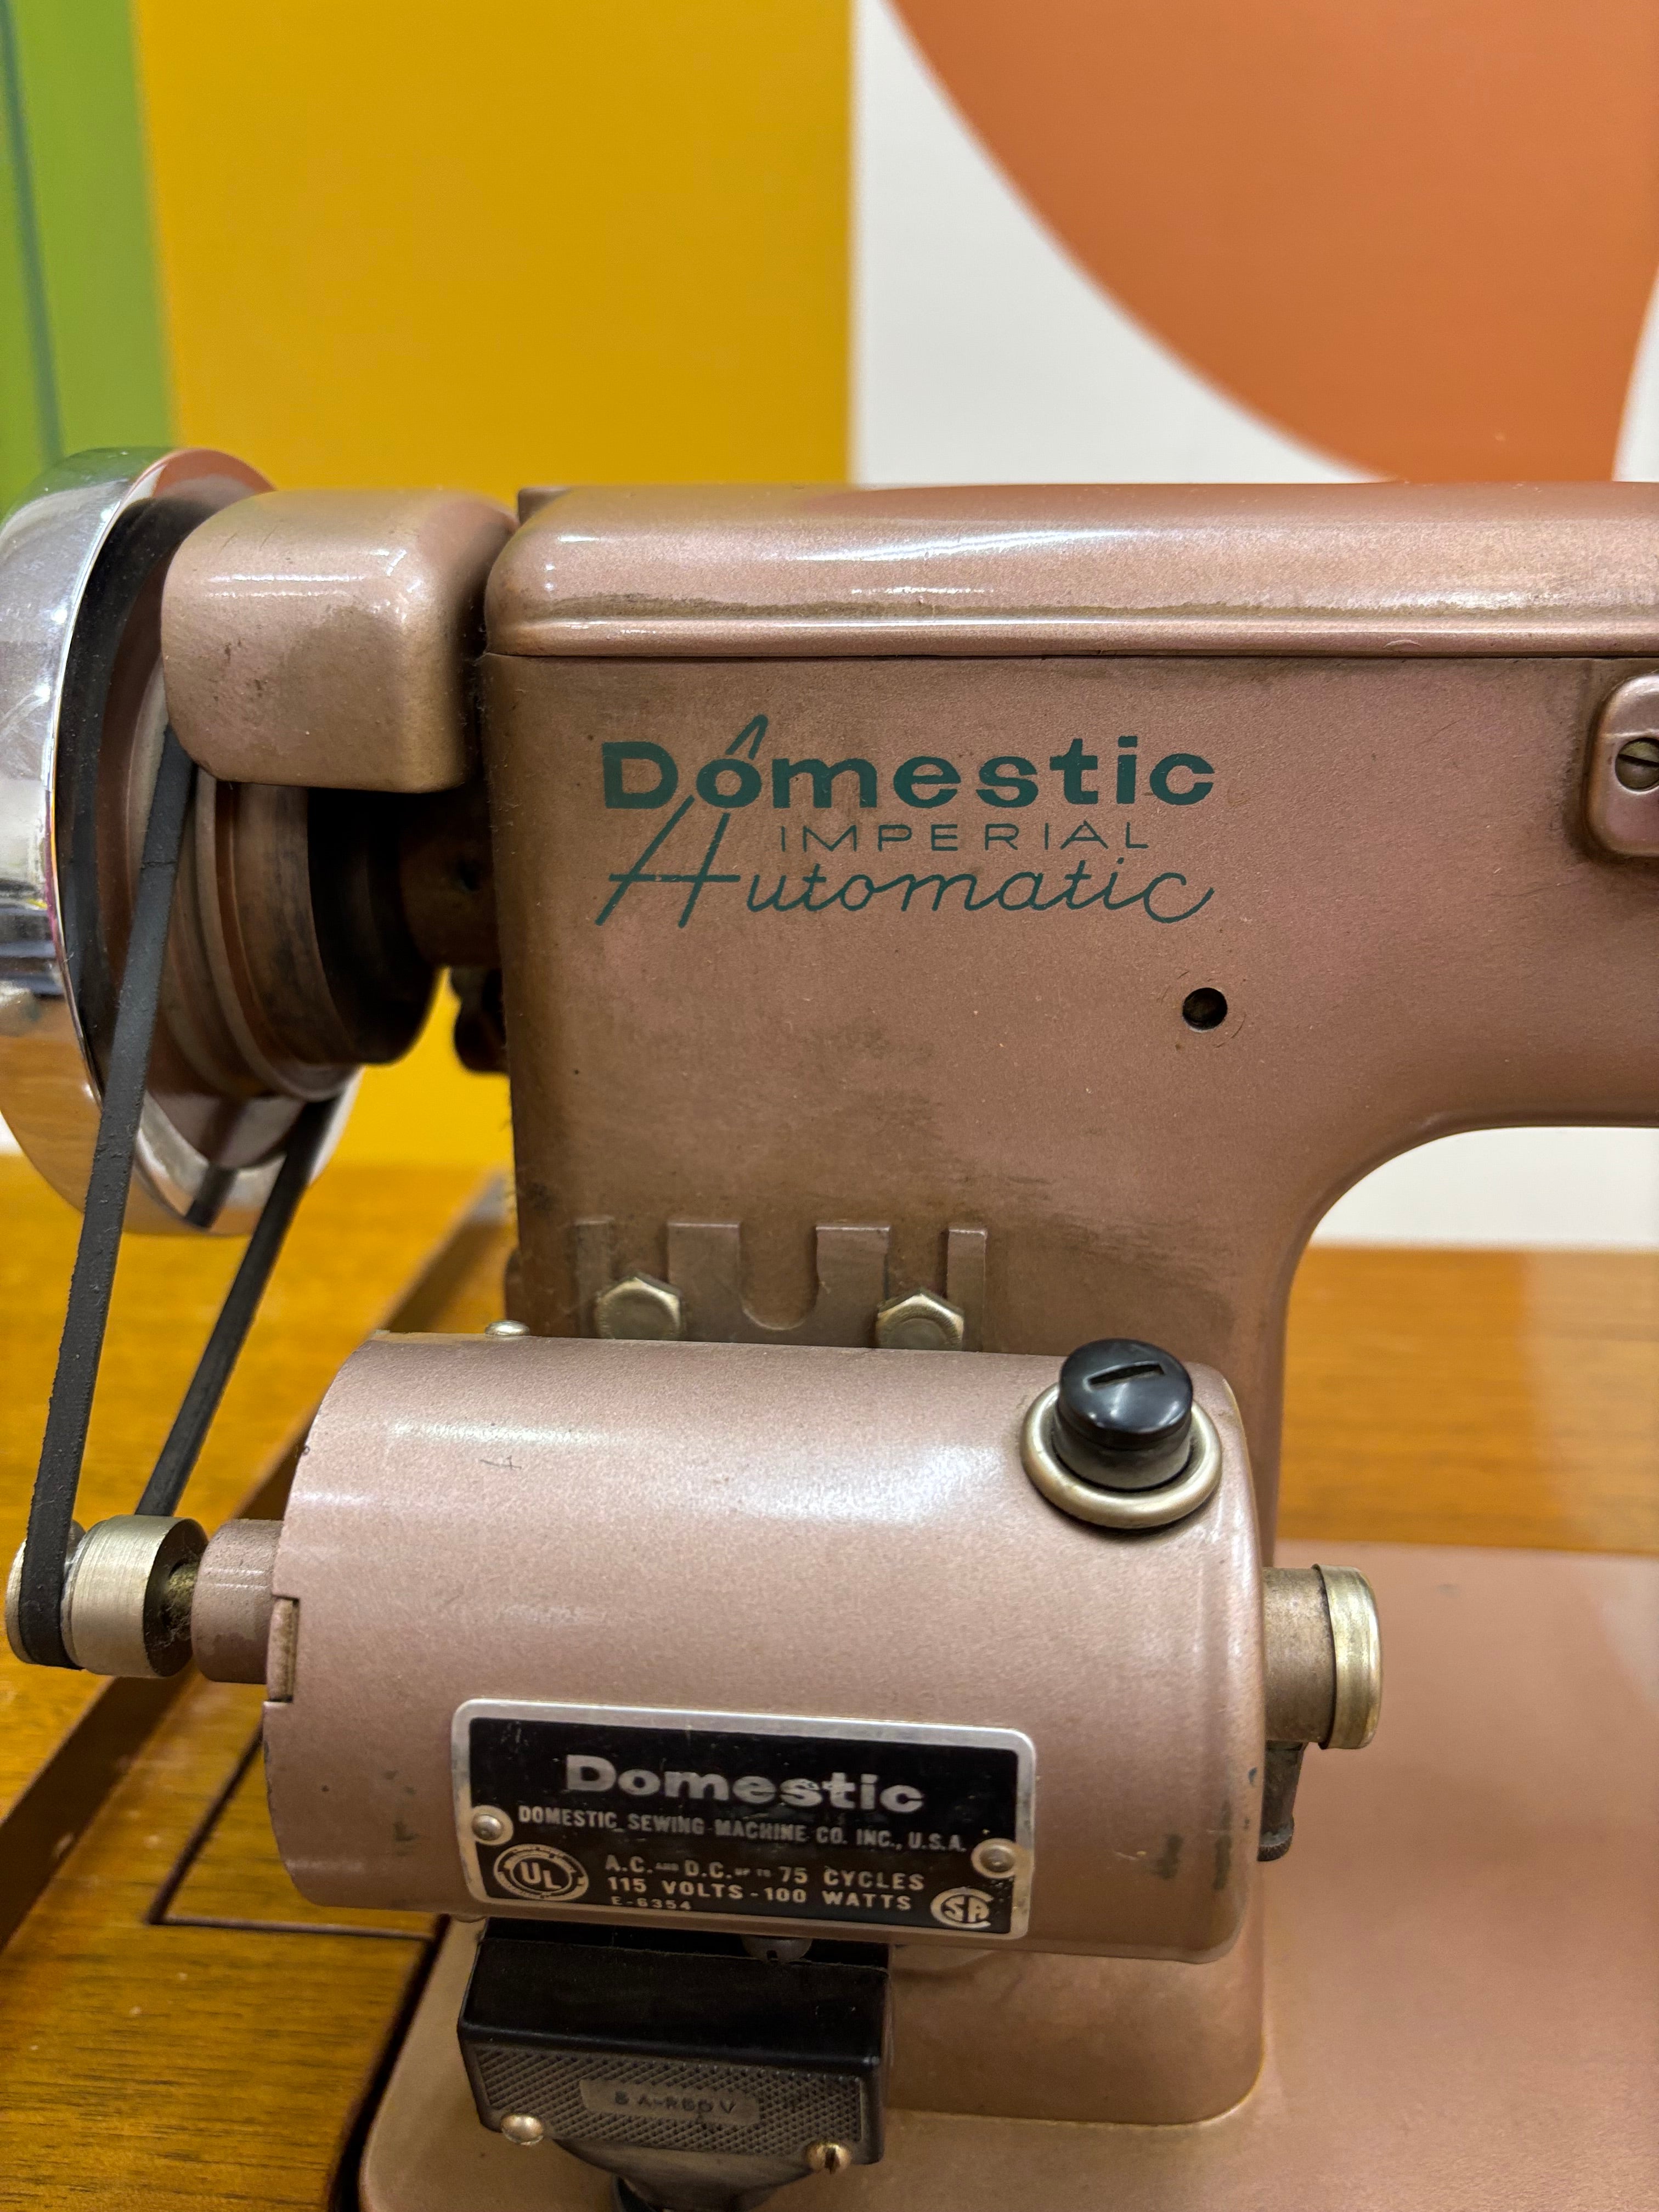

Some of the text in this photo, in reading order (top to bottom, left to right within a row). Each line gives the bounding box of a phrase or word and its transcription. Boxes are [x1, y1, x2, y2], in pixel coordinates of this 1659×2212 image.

[601, 735, 1216, 810] Domestic
[594, 714, 1215, 929] Automatic
[781, 819, 1150, 853] IMPERIAL
[566, 1753, 925, 1814] Domestic
[518, 1804, 618, 1829] DOMESTIC
[628, 1812, 706, 1836] SEWING
[714, 1819, 806, 1843] MACHINE
[816, 1825, 848, 1845] CO.
[908, 1831, 967, 1853] U.S.A.
[520, 1861, 562, 1890] UL
[605, 1853, 653, 1874] A.C.
[684, 1859, 733, 1880] D.C.
[778, 1865, 809, 1884] 75
[823, 1867, 925, 1891] CYCLES
[607, 1875, 647, 1893] 115
[661, 1879, 744, 1900] VOLTS
[822, 1889, 912, 1911] WATTS
[610, 1895, 692, 1911] E-6354
